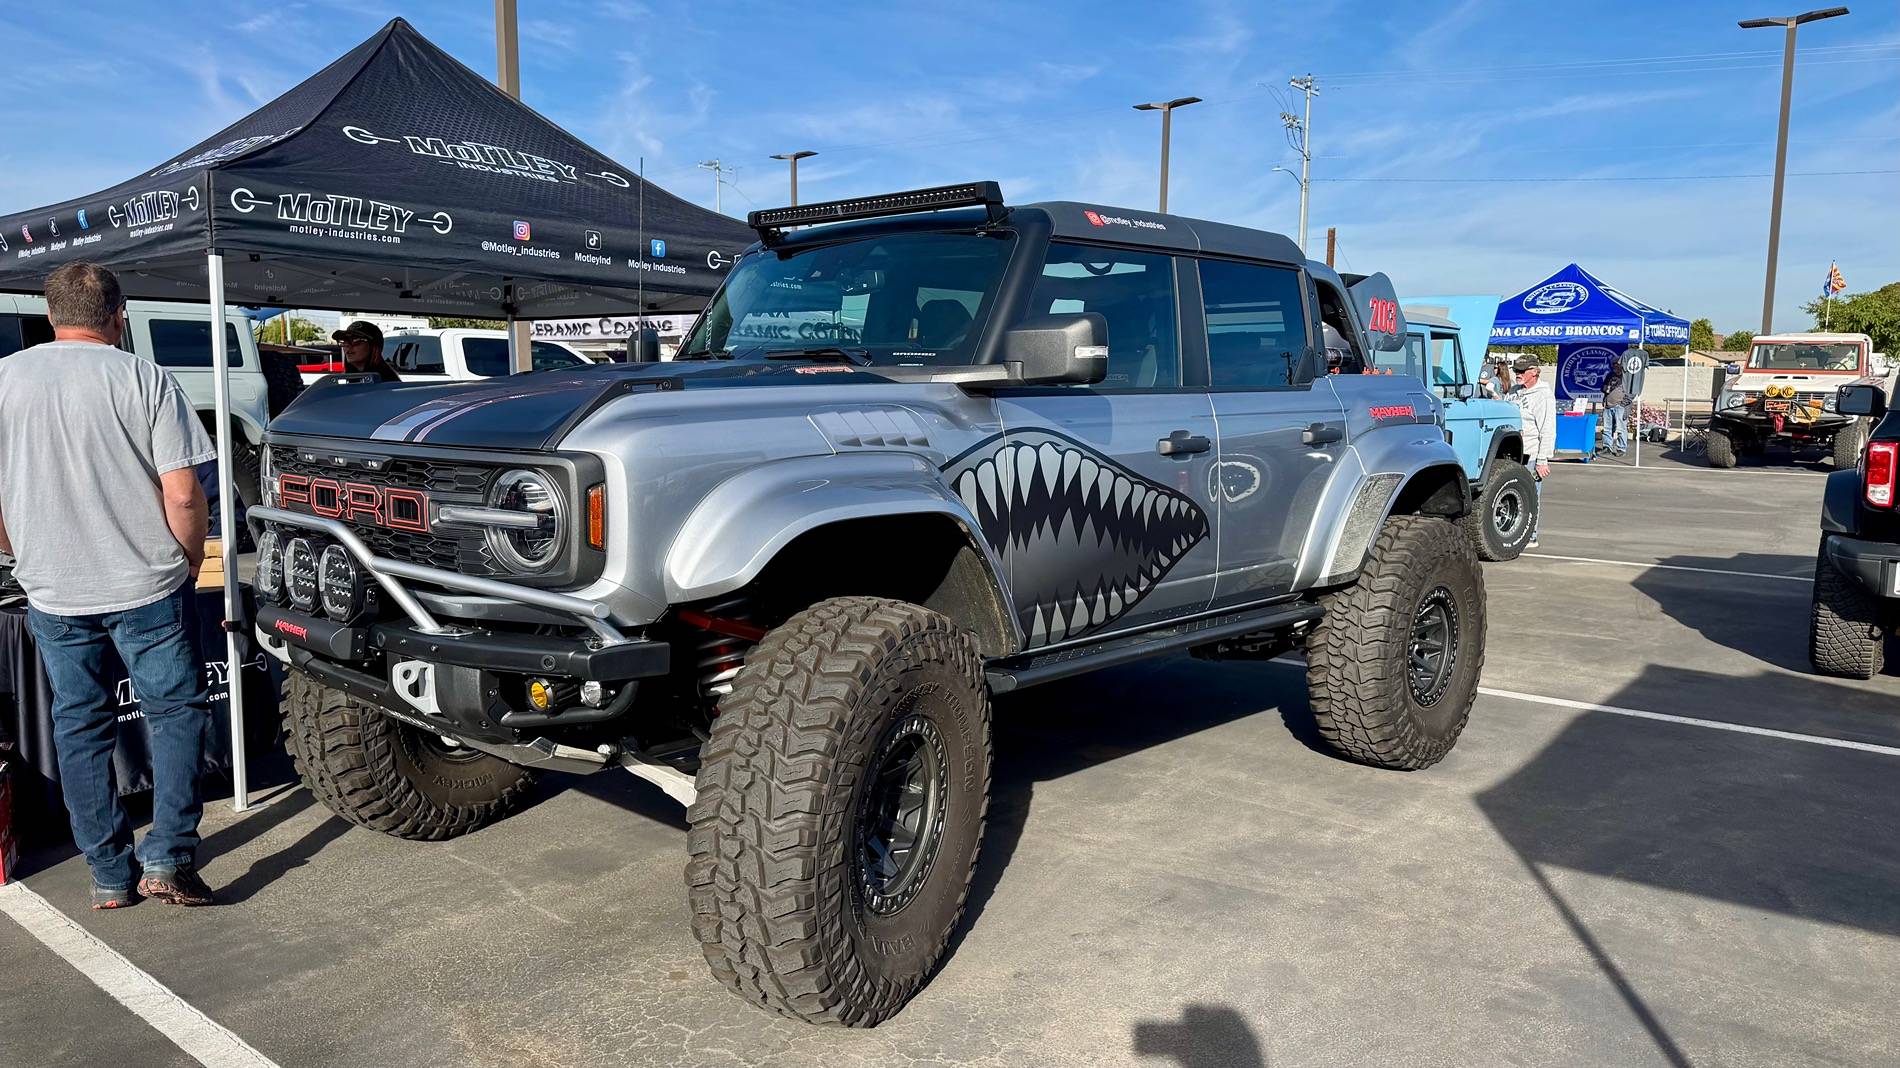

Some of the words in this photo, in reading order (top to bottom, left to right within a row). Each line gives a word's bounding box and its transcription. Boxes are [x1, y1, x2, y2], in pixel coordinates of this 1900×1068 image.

[458, 161, 559, 183] INDUSTRIES
[289, 224, 401, 244] motley-industries.com
[628, 259, 652, 272] Moley
[653, 263, 686, 275] Industries
[1368, 295, 1397, 336] 203
[1513, 325, 1562, 337] CLASSIC
[1565, 325, 1624, 336] BRONCOS
[1766, 386, 1777, 396] KC
[1782, 386, 1793, 397] KC
[1369, 405, 1416, 422] MAYHEM
[279, 473, 431, 532] FORD
[275, 619, 307, 642] MAYHEM
